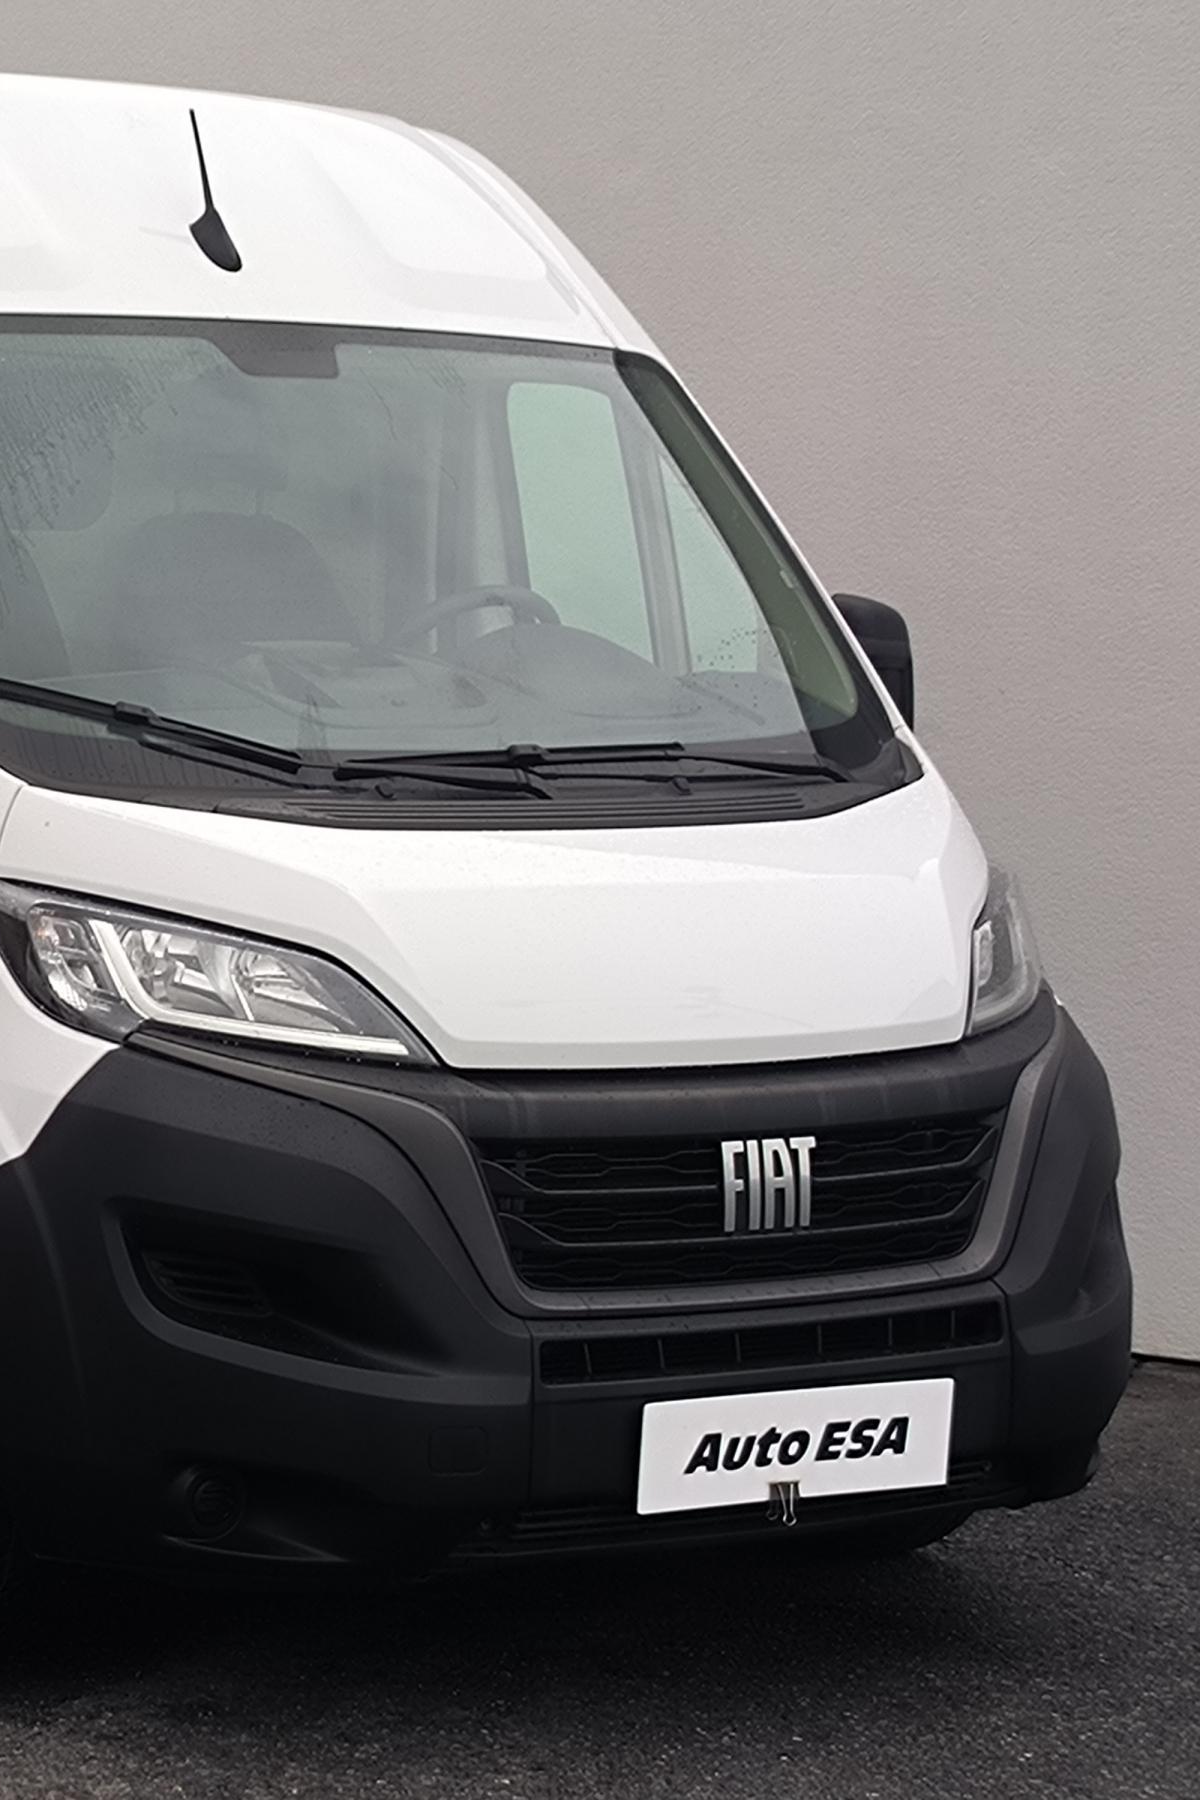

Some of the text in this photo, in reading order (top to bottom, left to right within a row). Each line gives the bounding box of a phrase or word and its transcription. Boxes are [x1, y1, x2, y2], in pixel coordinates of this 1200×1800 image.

[721, 1136, 816, 1232] FIAT
[683, 1416, 909, 1475] Auto ESA
